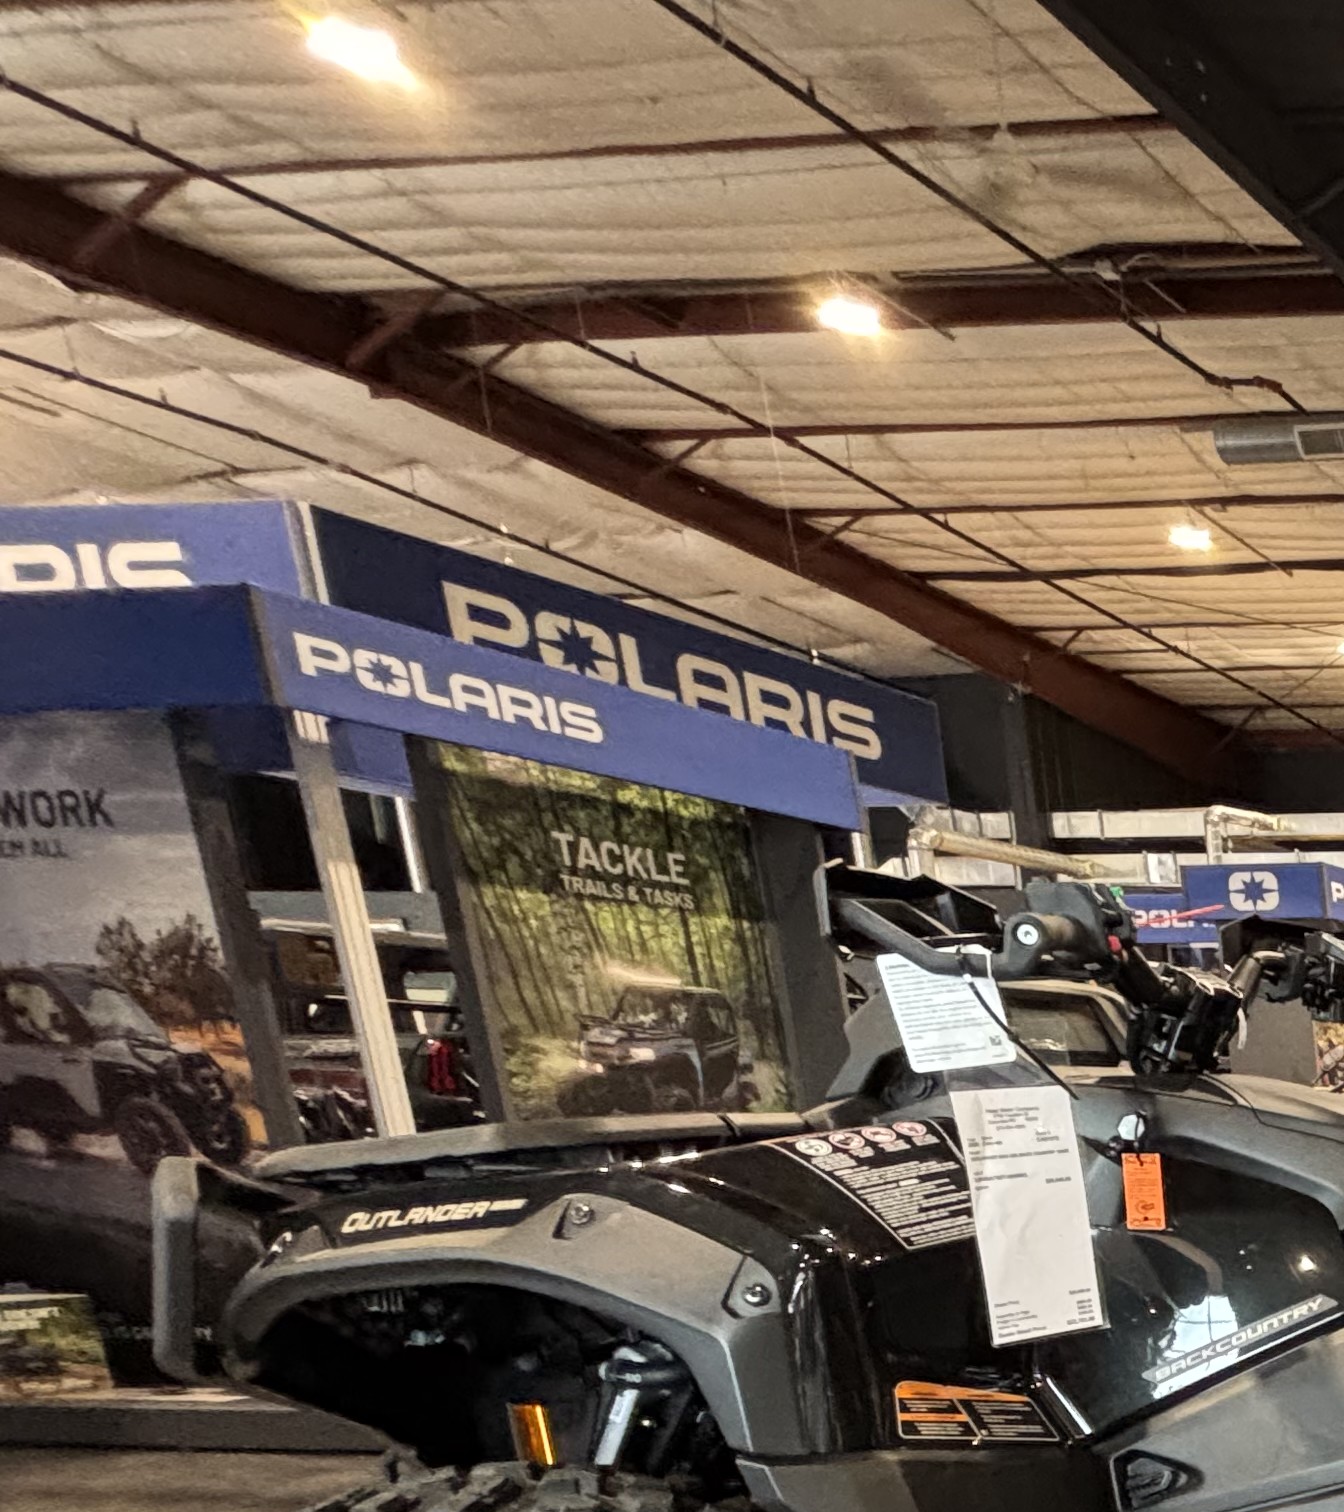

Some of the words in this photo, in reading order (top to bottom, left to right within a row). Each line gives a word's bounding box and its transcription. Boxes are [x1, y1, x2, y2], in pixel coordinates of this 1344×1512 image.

[293, 632, 603, 744] POLARIS
[442, 580, 882, 760] POLARIS
[551, 830, 690, 885] TACKLE
[559, 873, 624, 900] TRAILS
[627, 885, 639, 901] &
[643, 887, 695, 911] TASKS
[341, 1201, 491, 1233] OUTLANDER
[1155, 1298, 1323, 1382] BACKCOUNTRY
